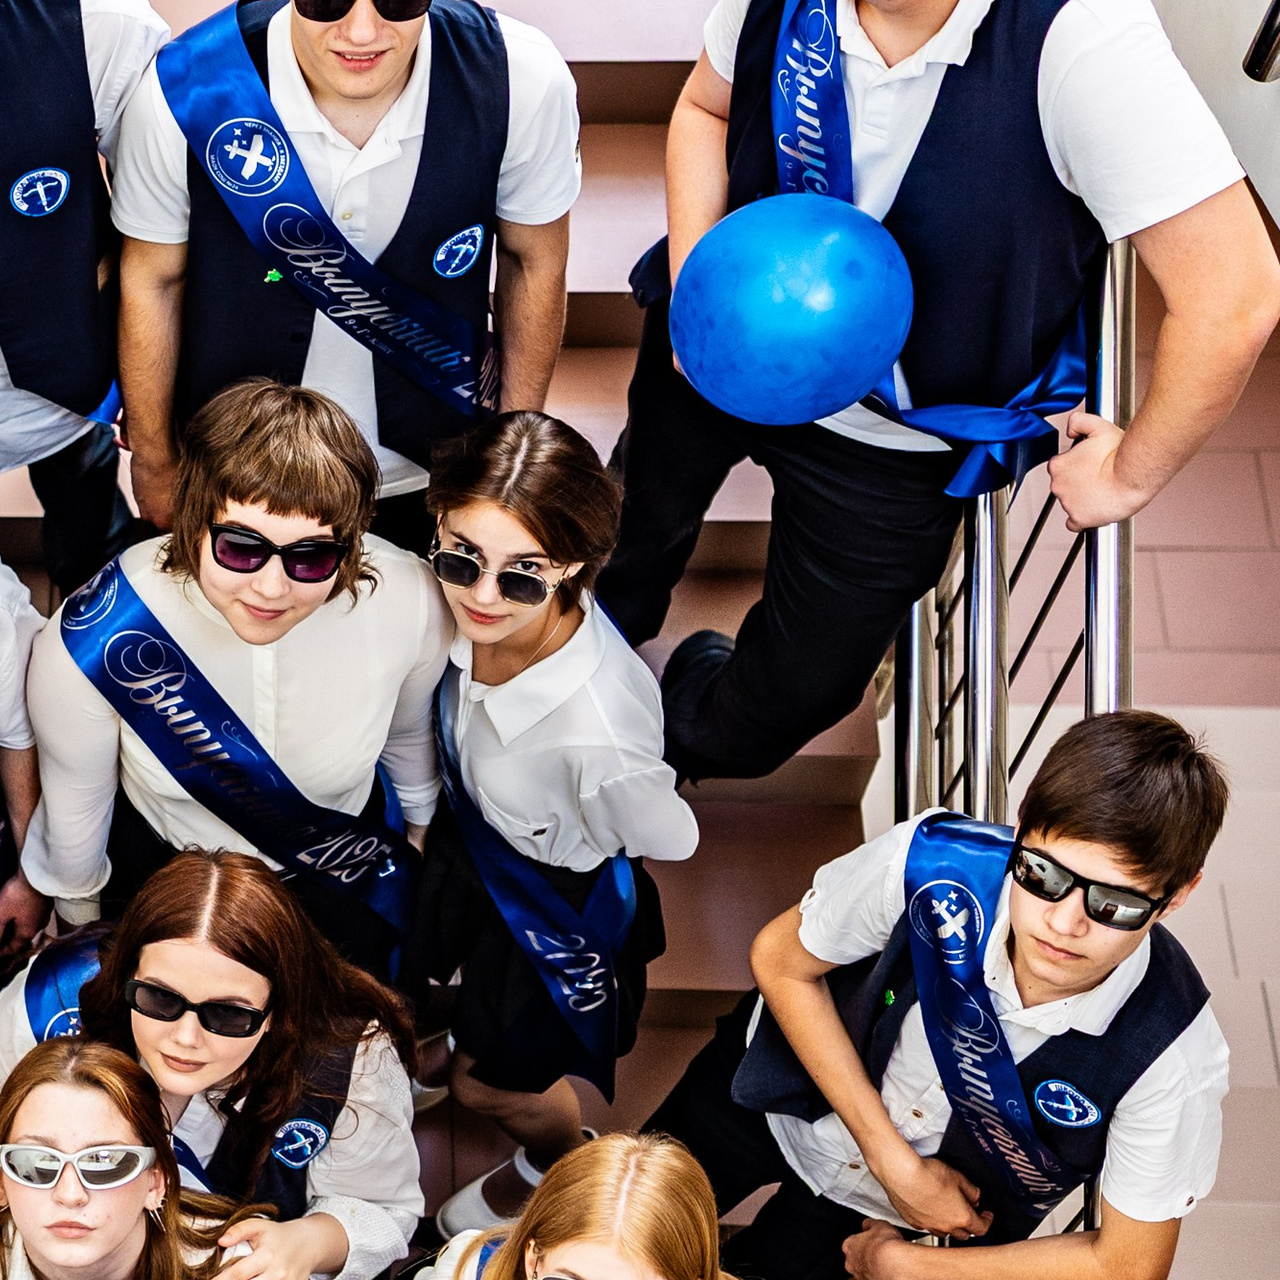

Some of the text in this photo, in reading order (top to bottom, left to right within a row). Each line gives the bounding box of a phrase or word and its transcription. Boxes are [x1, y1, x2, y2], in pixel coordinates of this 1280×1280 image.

[263, 203, 471, 372] Выпускник
[296, 829, 394, 883] 2025
[934, 977, 1064, 1195] Выпускник
